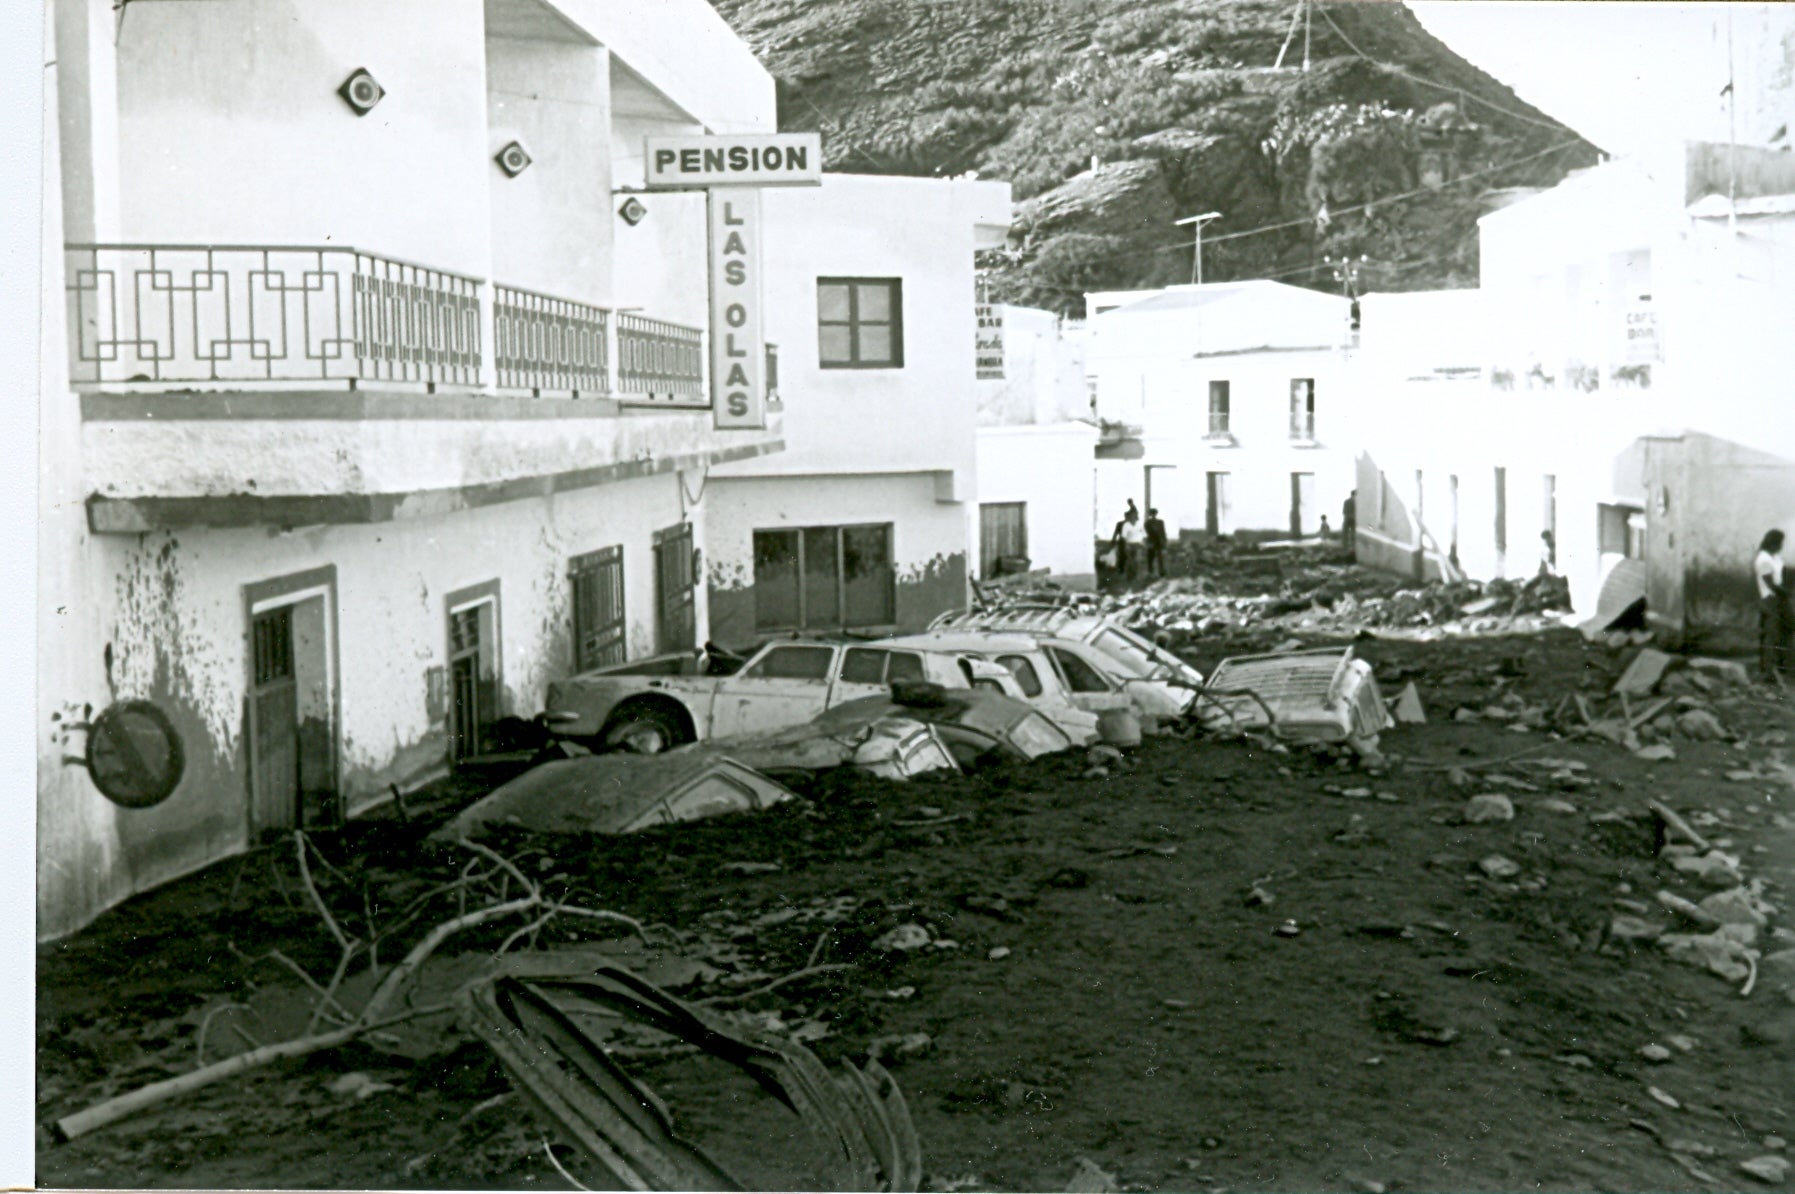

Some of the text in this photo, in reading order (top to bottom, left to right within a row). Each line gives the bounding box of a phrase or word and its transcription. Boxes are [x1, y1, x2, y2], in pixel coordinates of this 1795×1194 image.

[655, 146, 808, 173] PENSION
[723, 201, 750, 418] LAS OLAS
[978, 317, 1003, 328] BAR
